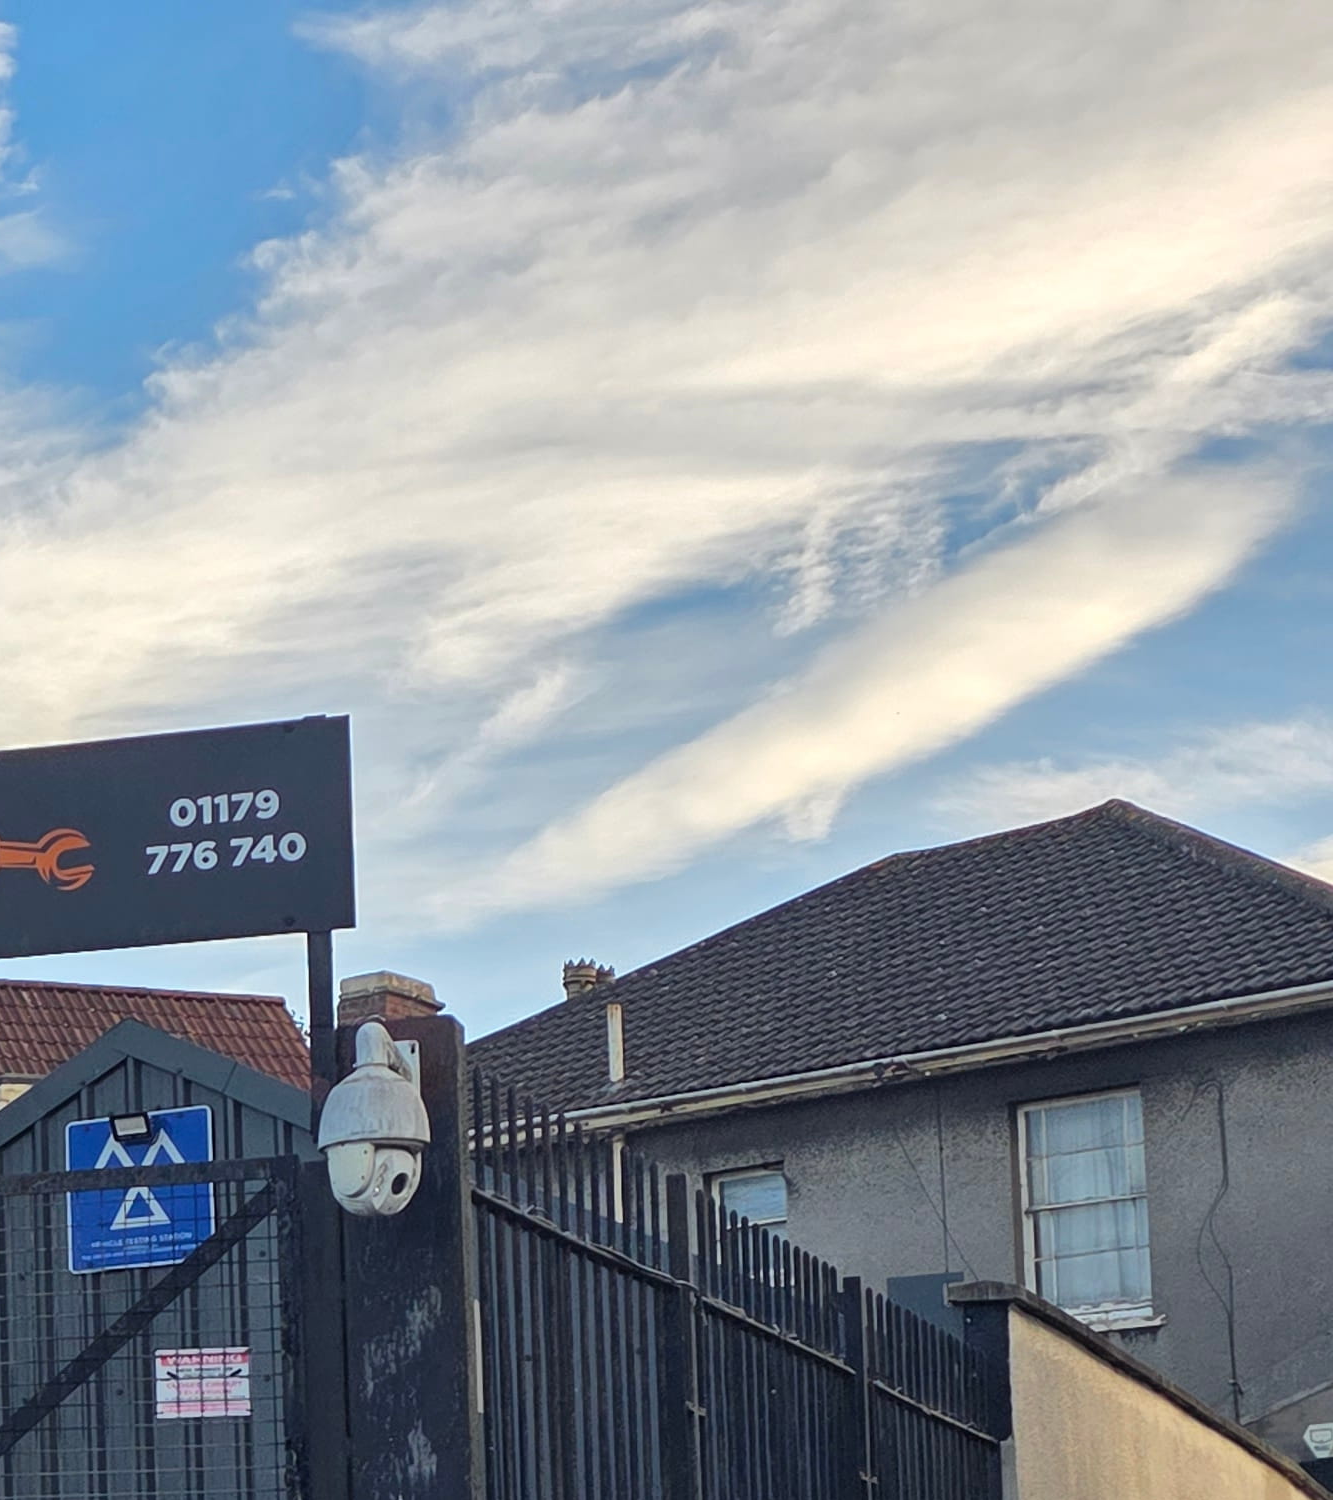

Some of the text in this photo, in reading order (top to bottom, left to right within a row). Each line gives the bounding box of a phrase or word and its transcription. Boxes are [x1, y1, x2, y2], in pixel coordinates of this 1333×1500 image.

[169, 788, 280, 828] 01179
[145, 832, 308, 876] 776 740
